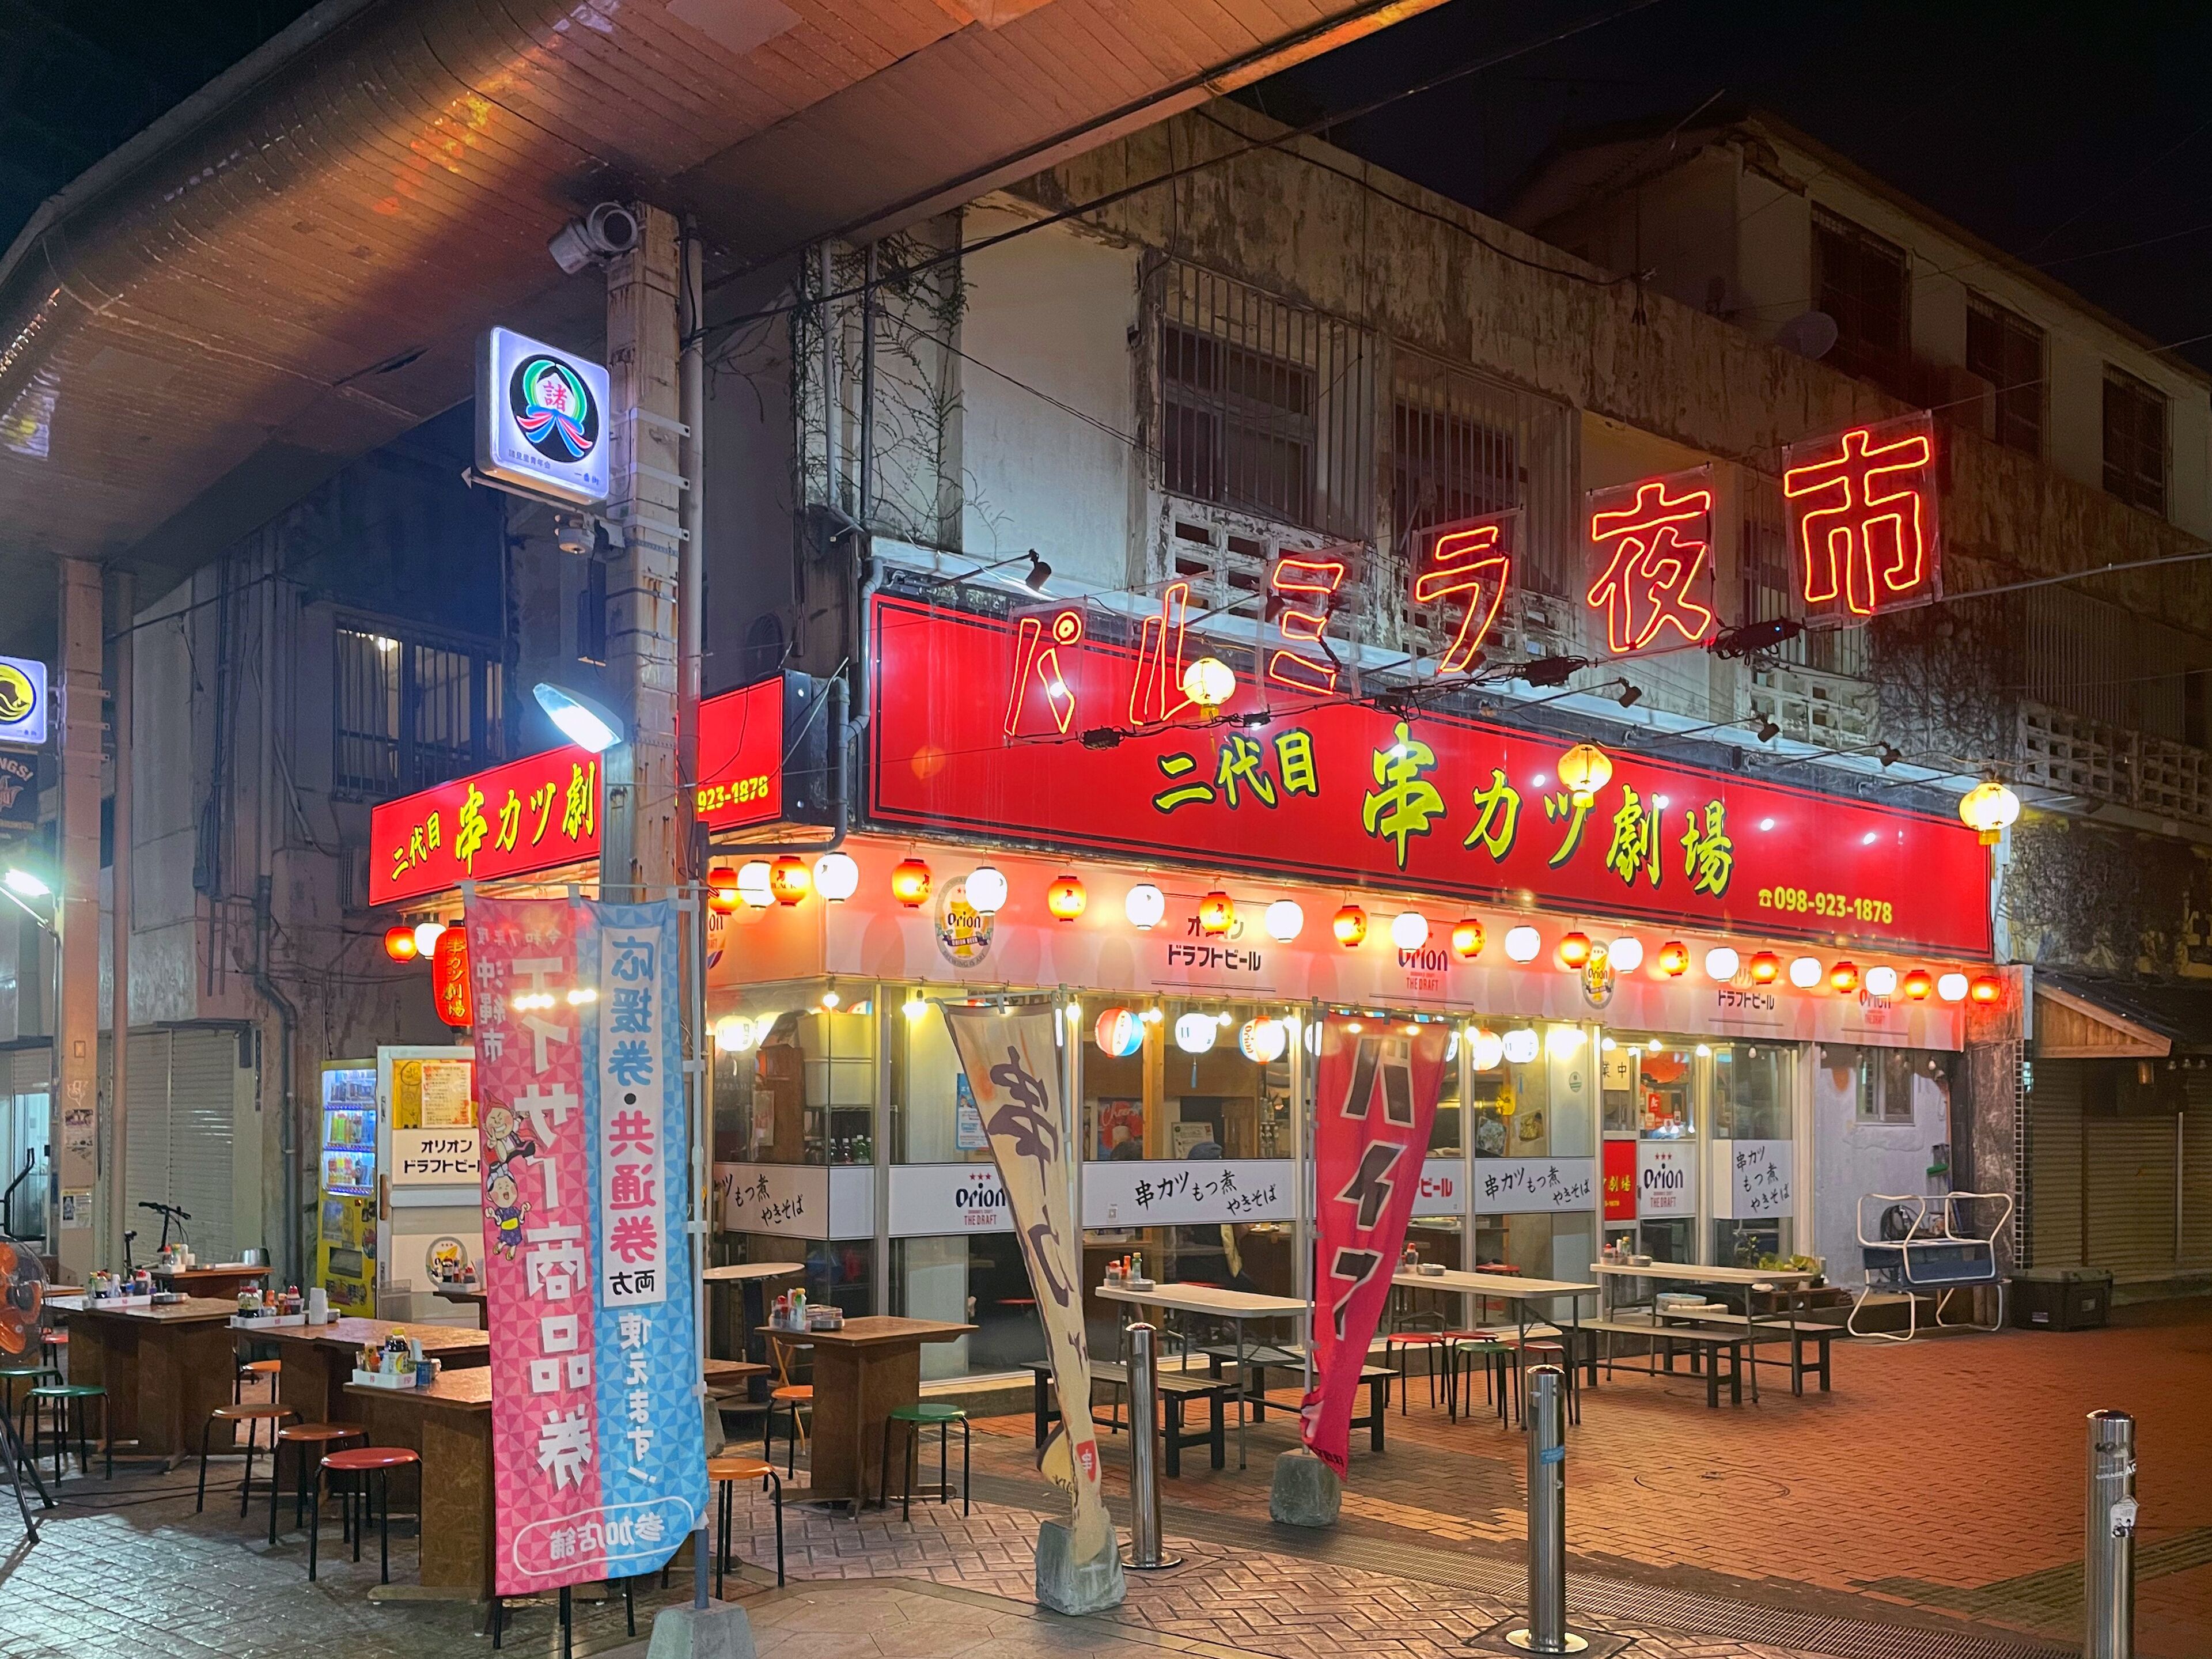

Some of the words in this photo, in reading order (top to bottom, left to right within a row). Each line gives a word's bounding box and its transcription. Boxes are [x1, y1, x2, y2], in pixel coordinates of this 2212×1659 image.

[543, 380, 567, 412] 諸
[1003, 428, 1931, 737] パルミラ夜市
[1152, 727, 1319, 812] 二代目
[1362, 721, 1734, 900] 串カツ劇場
[391, 812, 441, 882] 二代目
[947, 911, 981, 929] Orion
[1774, 886, 1893, 925] 098-923-1878
[1168, 943, 1262, 972] ドラフトビール
[1406, 977, 1418, 990] THE
[1419, 978, 1439, 991] DRAFT
[1718, 989, 1775, 1010] ドラフトビール
[421, 1139, 472, 1154] オリオン
[1736, 1145, 1766, 1172] 串カツ
[734, 1173, 771, 1207] もつ煮
[1134, 1171, 1190, 1211] 串カツ
[1192, 1169, 1237, 1202] もつ煮
[1418, 1177, 1453, 1198] ビール
[1484, 1167, 1525, 1201] 串カツ
[1527, 1165, 1561, 1194] もつ煮
[1552, 1179, 1591, 1206] やきそば
[1743, 1162, 1779, 1193] もつ煮
[761, 1194, 804, 1227] やきそば
[1226, 1183, 1278, 1215] やきそば
[1751, 1183, 1790, 1214] やきそば
[964, 1215, 976, 1226] THE
[976, 1214, 997, 1225] DRAFT
